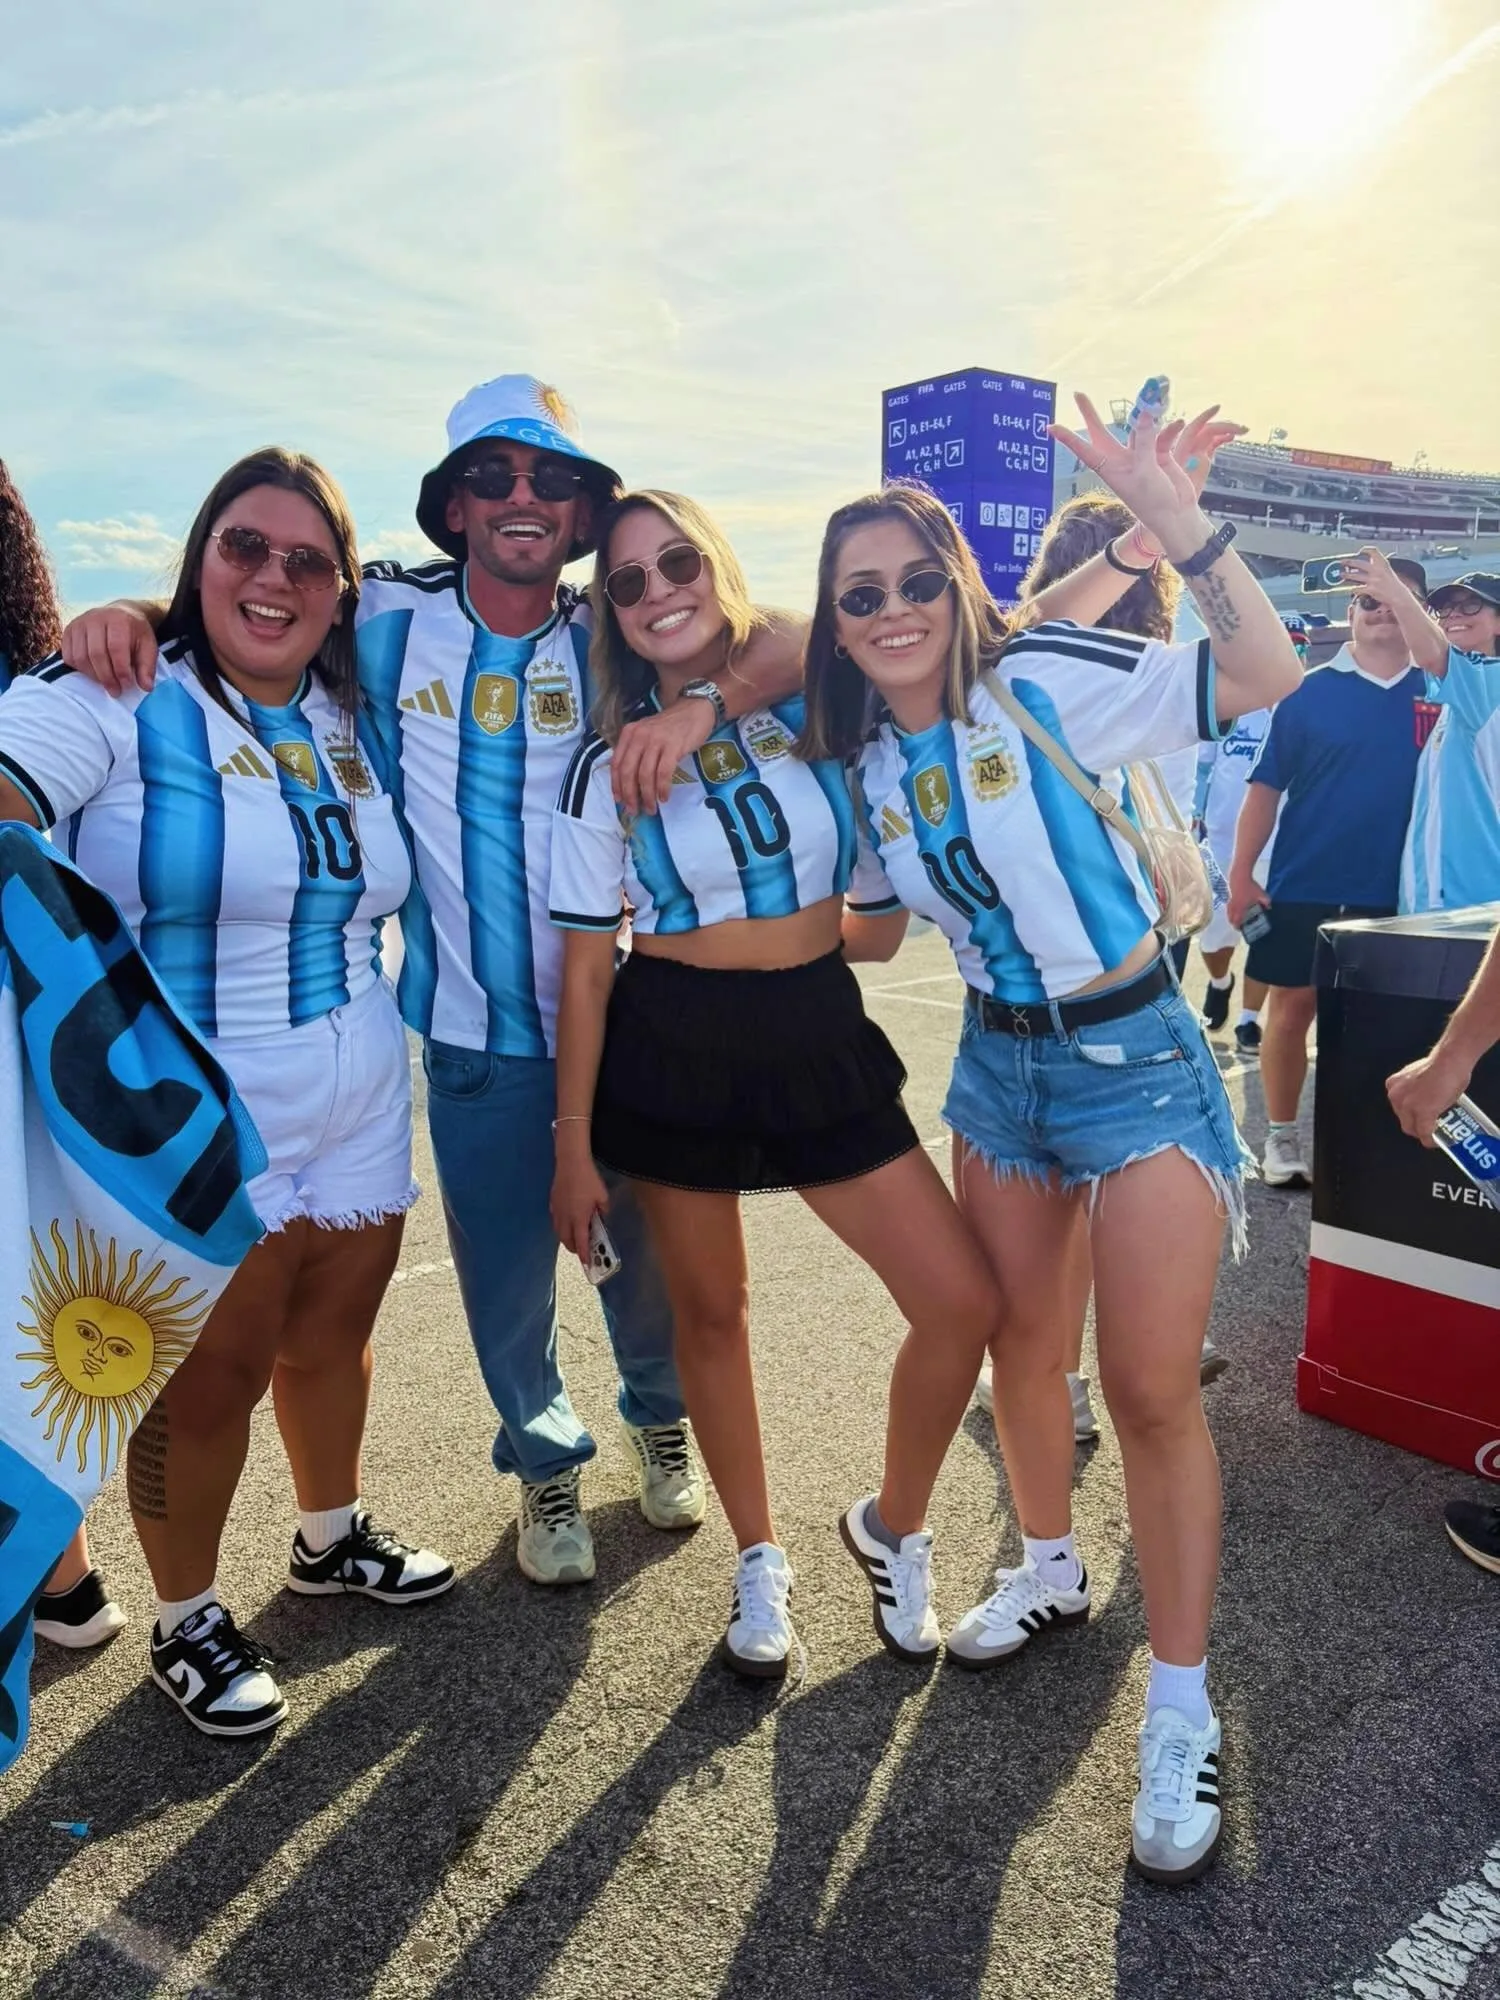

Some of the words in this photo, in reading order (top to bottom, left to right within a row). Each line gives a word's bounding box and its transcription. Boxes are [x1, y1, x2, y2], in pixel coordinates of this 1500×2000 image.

[887, 395, 909, 408] GATES
[918, 383, 934, 395] FIFA
[943, 380, 967, 394] GATES
[982, 379, 1003, 392] GATES
[1010, 379, 1026, 391] FIFA
[1033, 389, 1052, 401] GATES
[934, 459, 940, 470] H
[483, 711, 505, 721] FIFA
[542, 692, 567, 718] AFA
[979, 753, 1007, 783] AFA
[704, 780, 792, 870] 10
[287, 802, 363, 881] 10
[920, 835, 1001, 916] 10
